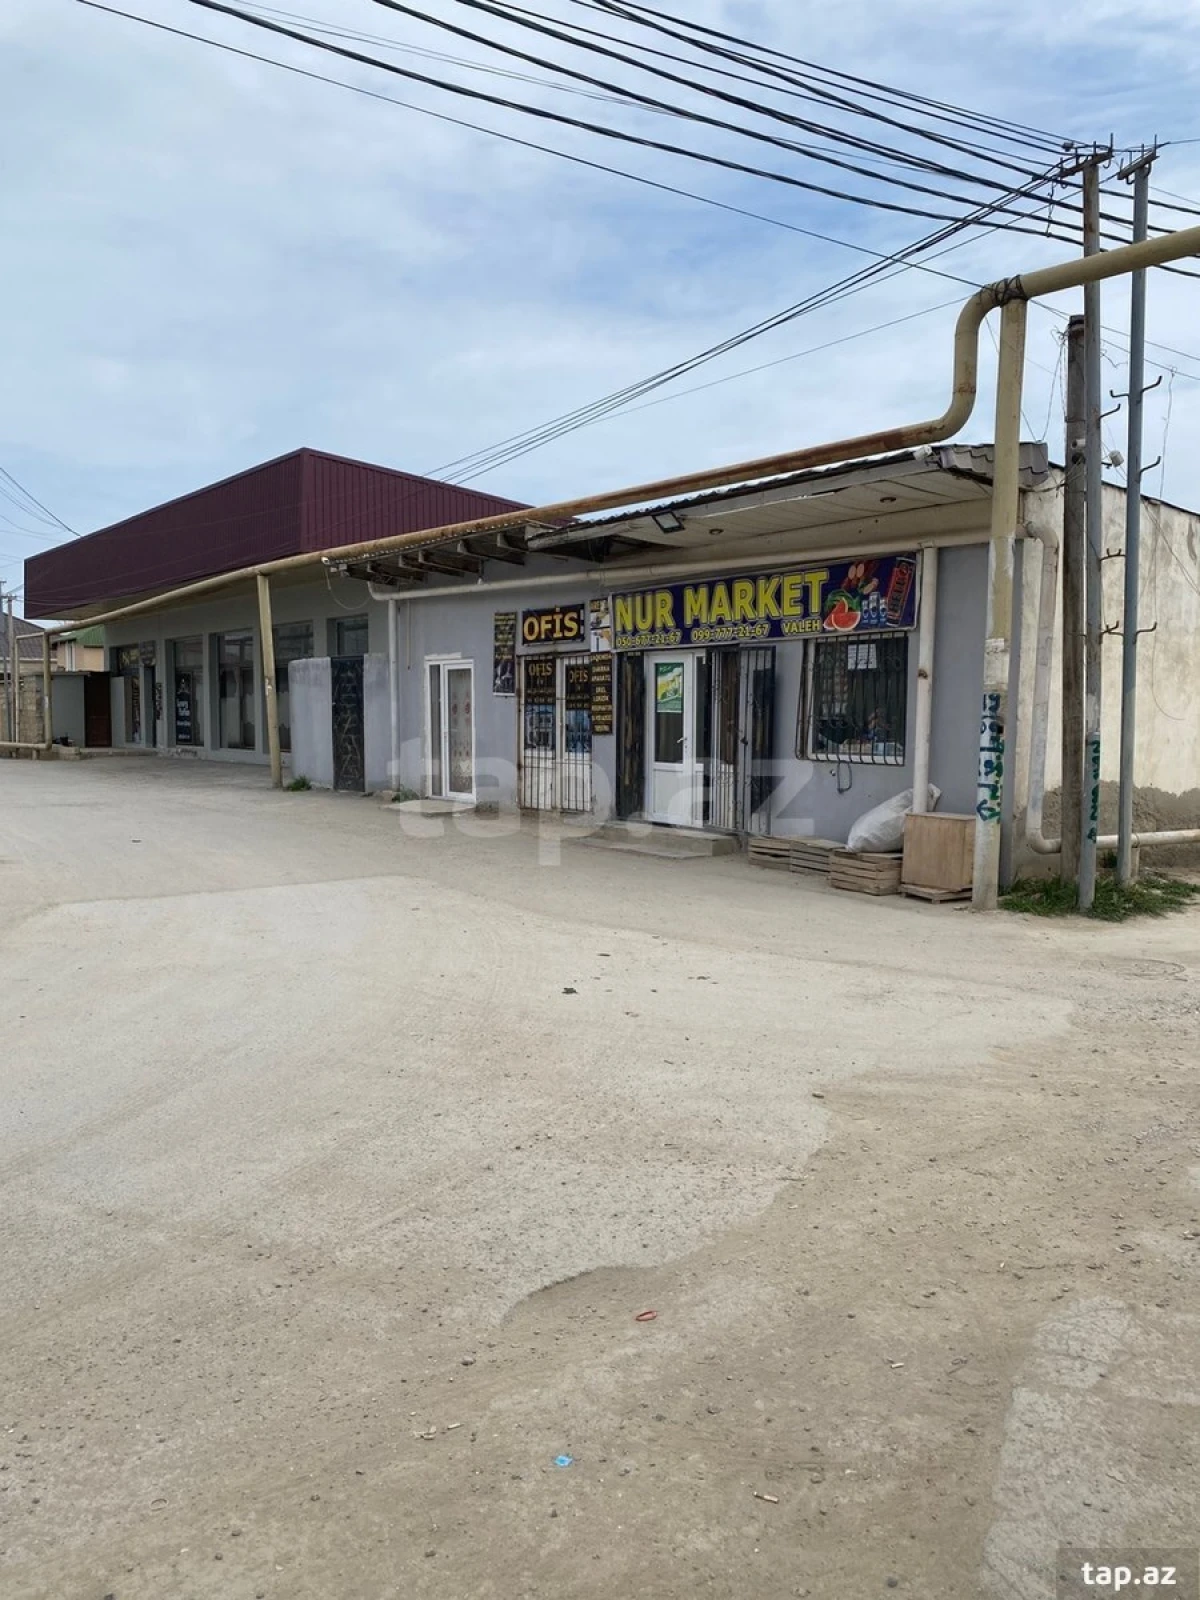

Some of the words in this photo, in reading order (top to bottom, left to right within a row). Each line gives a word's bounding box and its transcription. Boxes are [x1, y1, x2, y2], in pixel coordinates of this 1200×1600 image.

[616, 590, 674, 632] NUR
[684, 569, 829, 627] MARKET
[783, 619, 820, 633] VALEH
